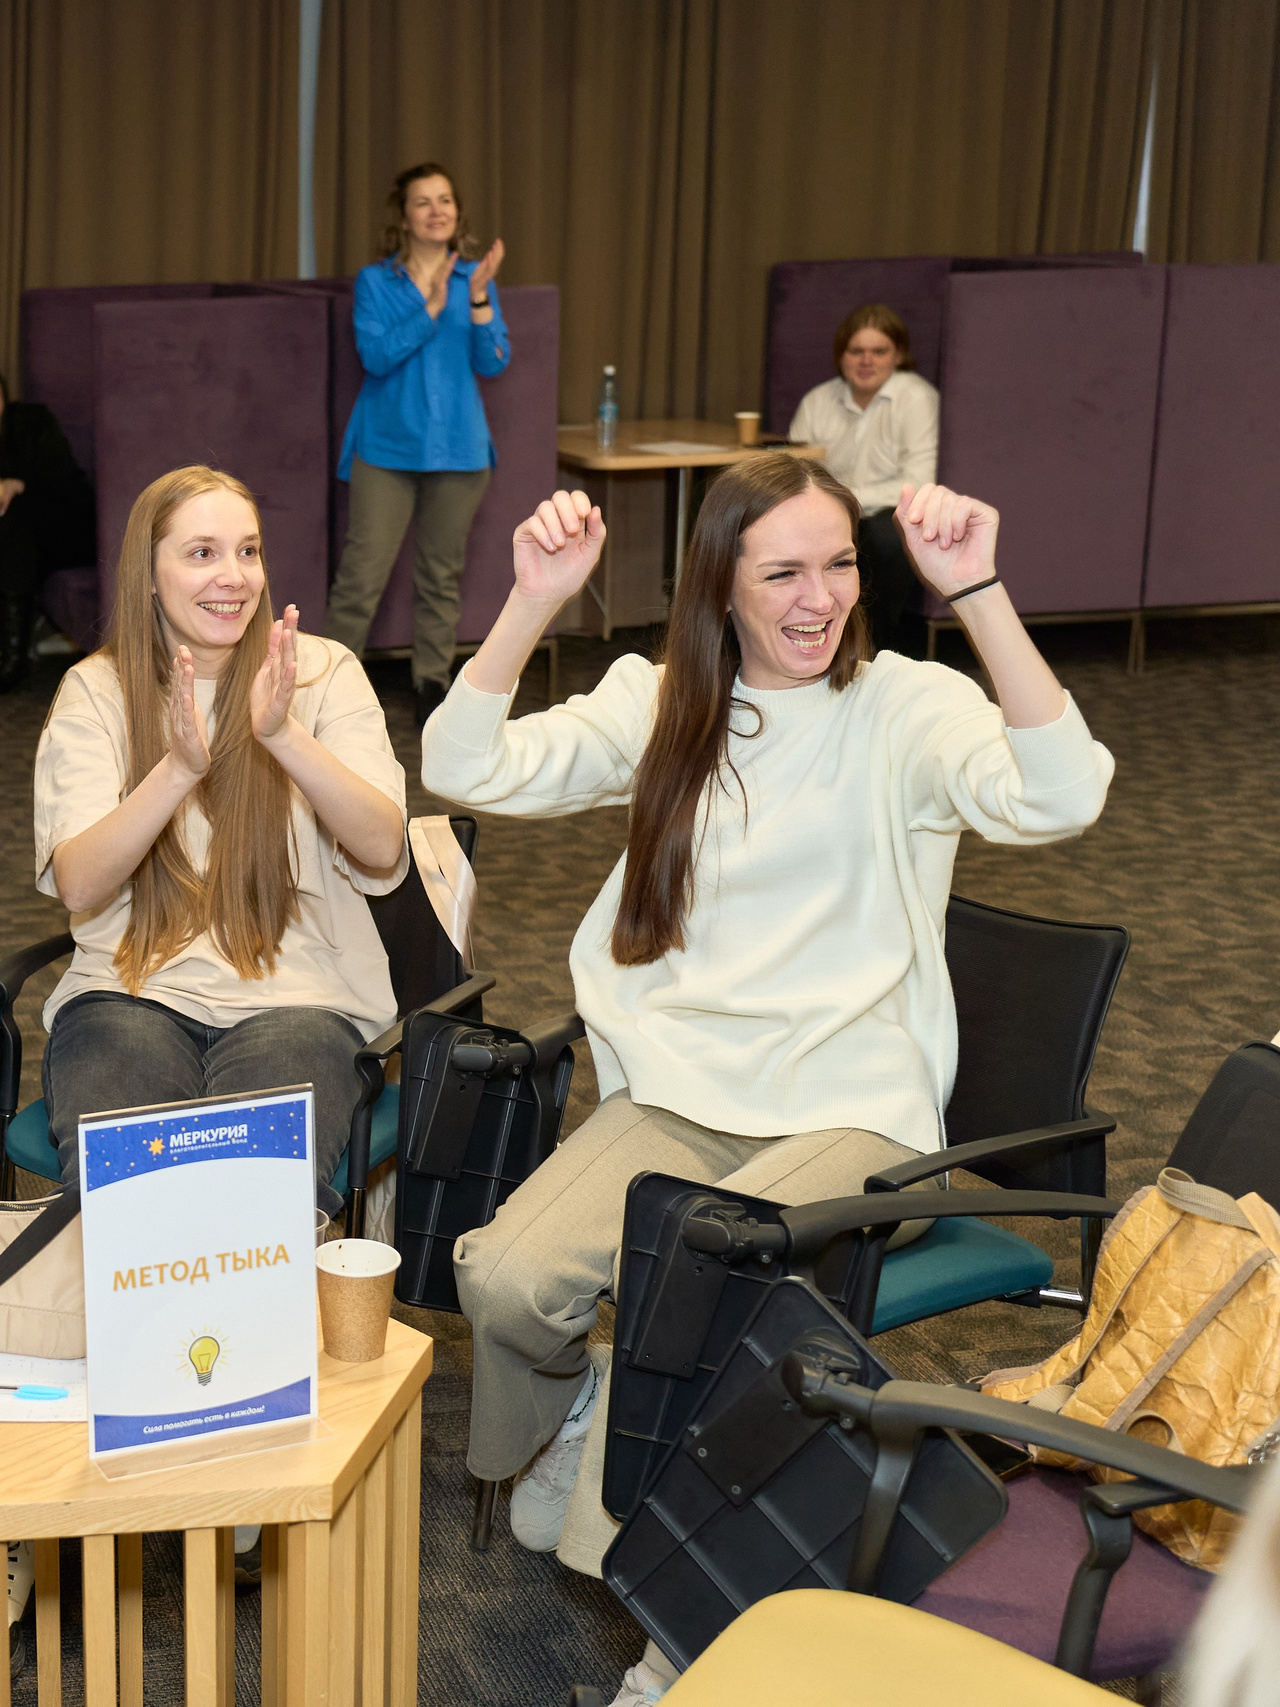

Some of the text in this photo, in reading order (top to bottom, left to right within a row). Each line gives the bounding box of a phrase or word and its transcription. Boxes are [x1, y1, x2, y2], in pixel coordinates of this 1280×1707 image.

[169, 1123, 248, 1148] МЕРКУРИЯ
[113, 1243, 291, 1292] МЕТОД ТЫКА
[143, 1425, 163, 1434] Сила
[163, 1417, 204, 1431] помогать
[204, 1413, 224, 1424] есть
[230, 1405, 266, 1418] каждом!
